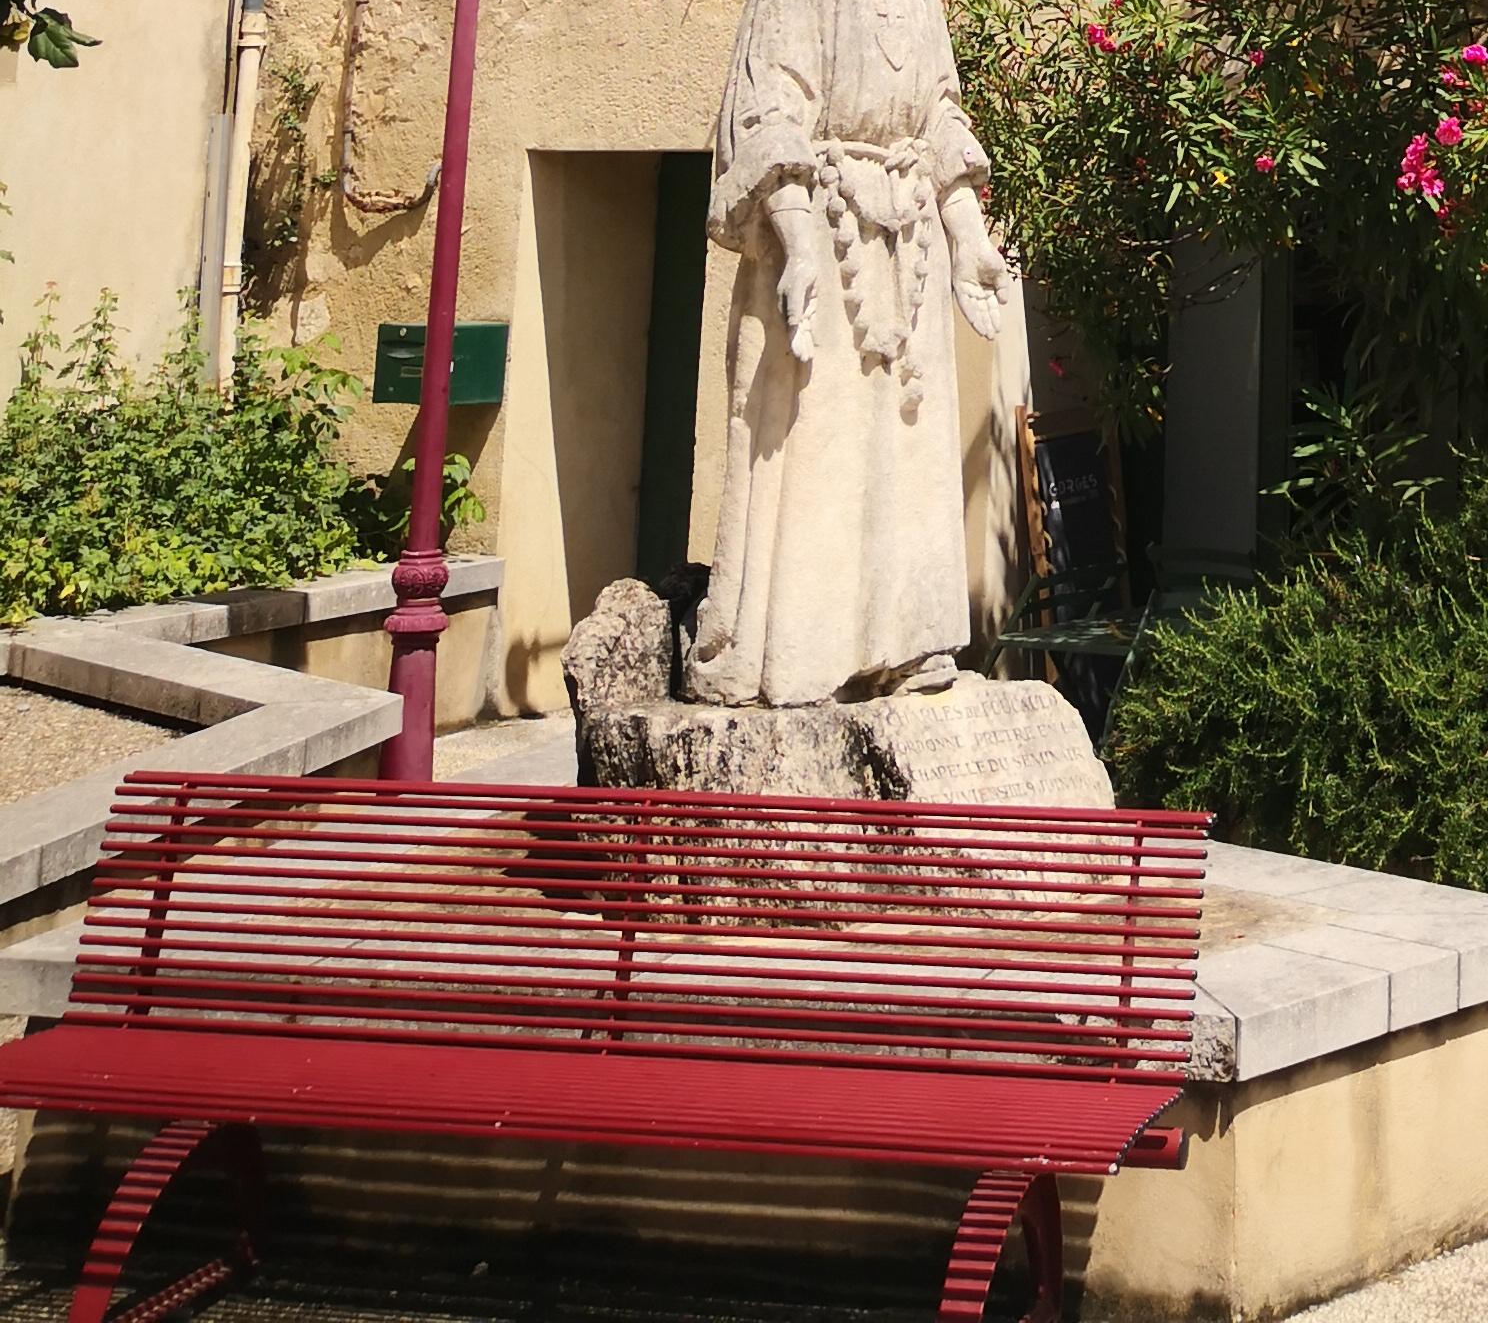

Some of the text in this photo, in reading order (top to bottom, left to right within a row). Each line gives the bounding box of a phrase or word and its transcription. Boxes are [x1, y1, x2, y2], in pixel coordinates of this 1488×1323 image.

[885, 704, 964, 726] CHARLES
[909, 759, 986, 782] CHAPELLE
[987, 756, 1010, 773] DU
